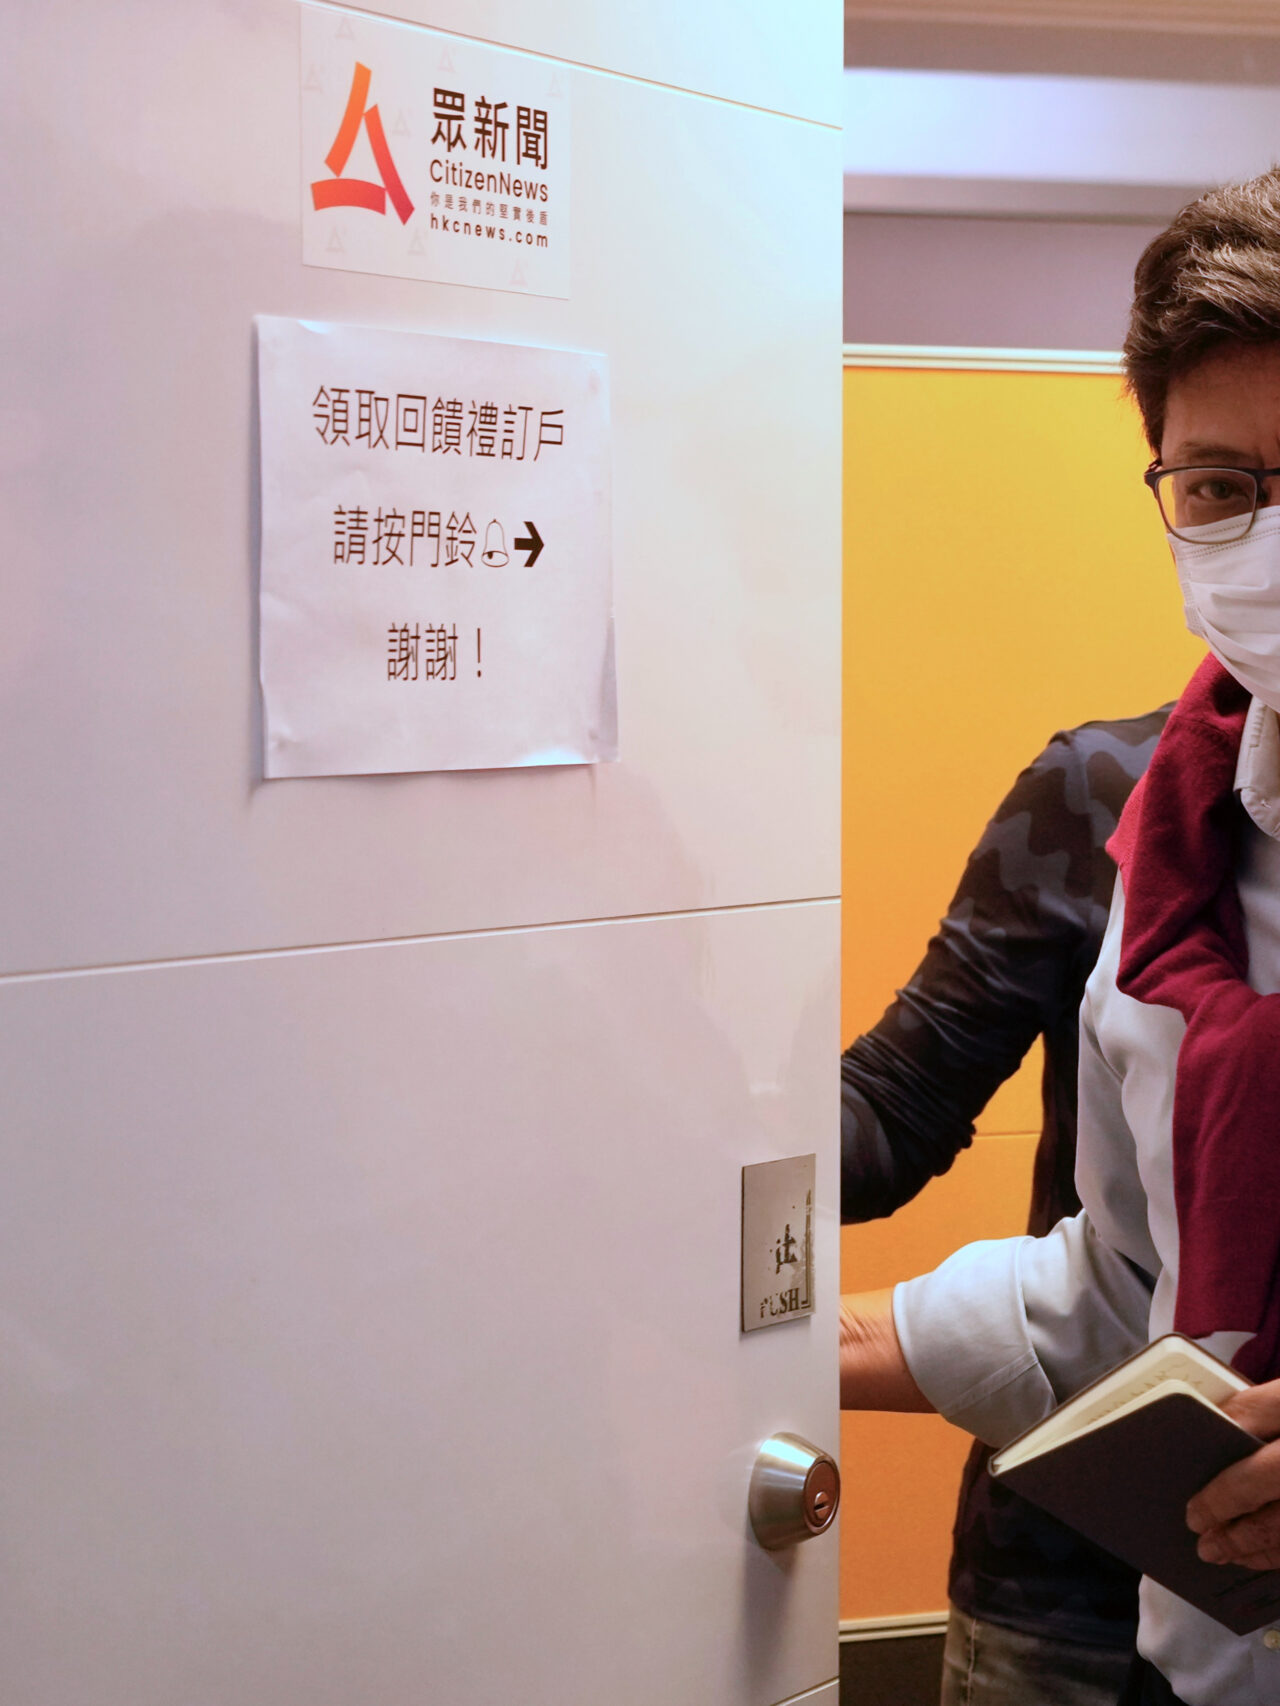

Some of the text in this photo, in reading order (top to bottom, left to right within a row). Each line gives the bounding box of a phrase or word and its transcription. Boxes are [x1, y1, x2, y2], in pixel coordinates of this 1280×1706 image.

[431, 87, 548, 170] 眾新聞
[430, 159, 549, 202] CitizenNews
[430, 191, 548, 226] 你是我們的堅實後盾
[430, 213, 548, 248] hkcnews.com
[312, 385, 566, 462] 領取回饋禮訂戶
[332, 504, 478, 568] 請按門鈴
